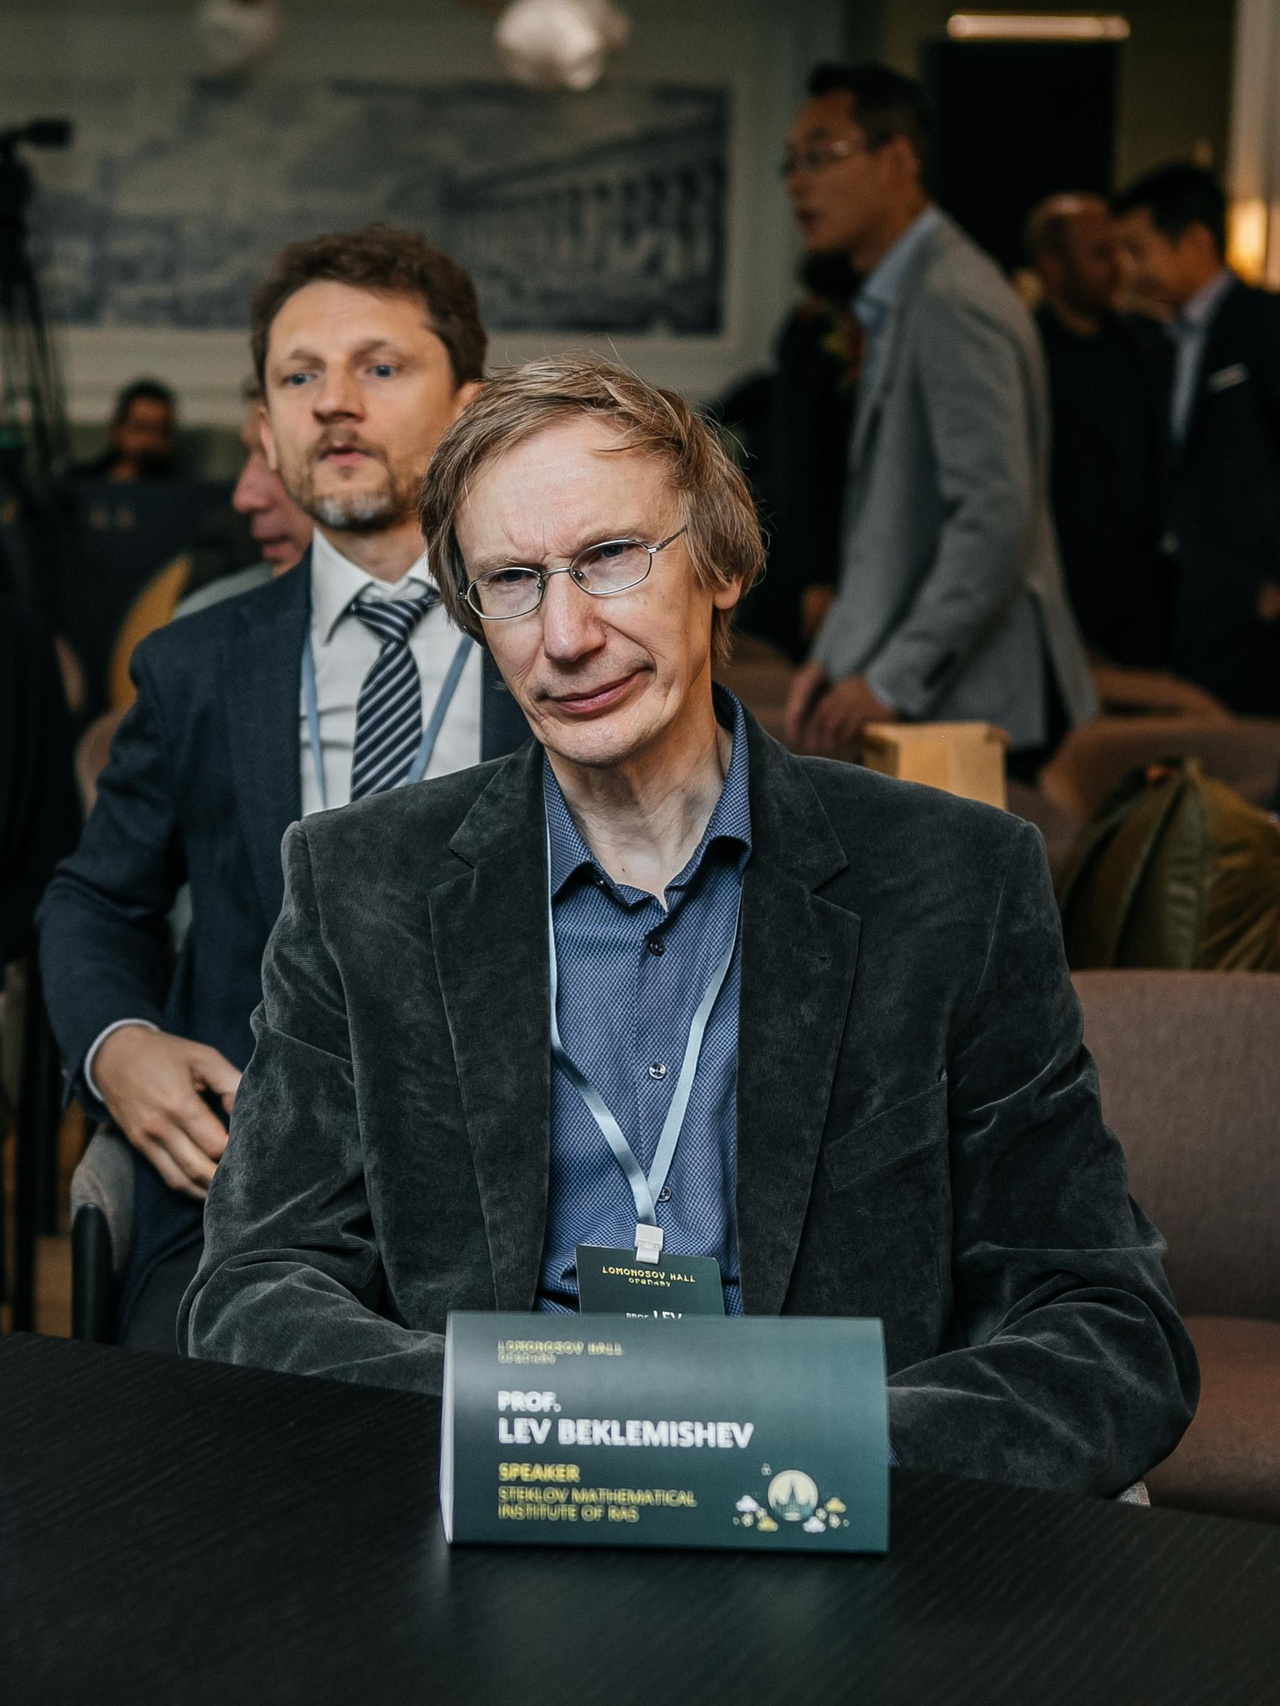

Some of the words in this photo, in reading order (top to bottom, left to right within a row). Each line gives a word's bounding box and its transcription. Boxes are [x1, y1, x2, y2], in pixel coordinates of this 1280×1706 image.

[602, 1266, 665, 1279] LOMONOSOV
[670, 1272, 696, 1283] HALL
[497, 1390, 562, 1413] PROF.
[498, 1417, 552, 1445] LEV
[558, 1418, 755, 1449] BEKLEMISHEV
[498, 1462, 580, 1483] SPEAKER
[498, 1486, 569, 1504] STEKLOV
[571, 1487, 699, 1507] MATHEMATICAL
[498, 1503, 578, 1522] INSTITUTE
[581, 1504, 604, 1522] OF
[608, 1505, 639, 1523] RAS
